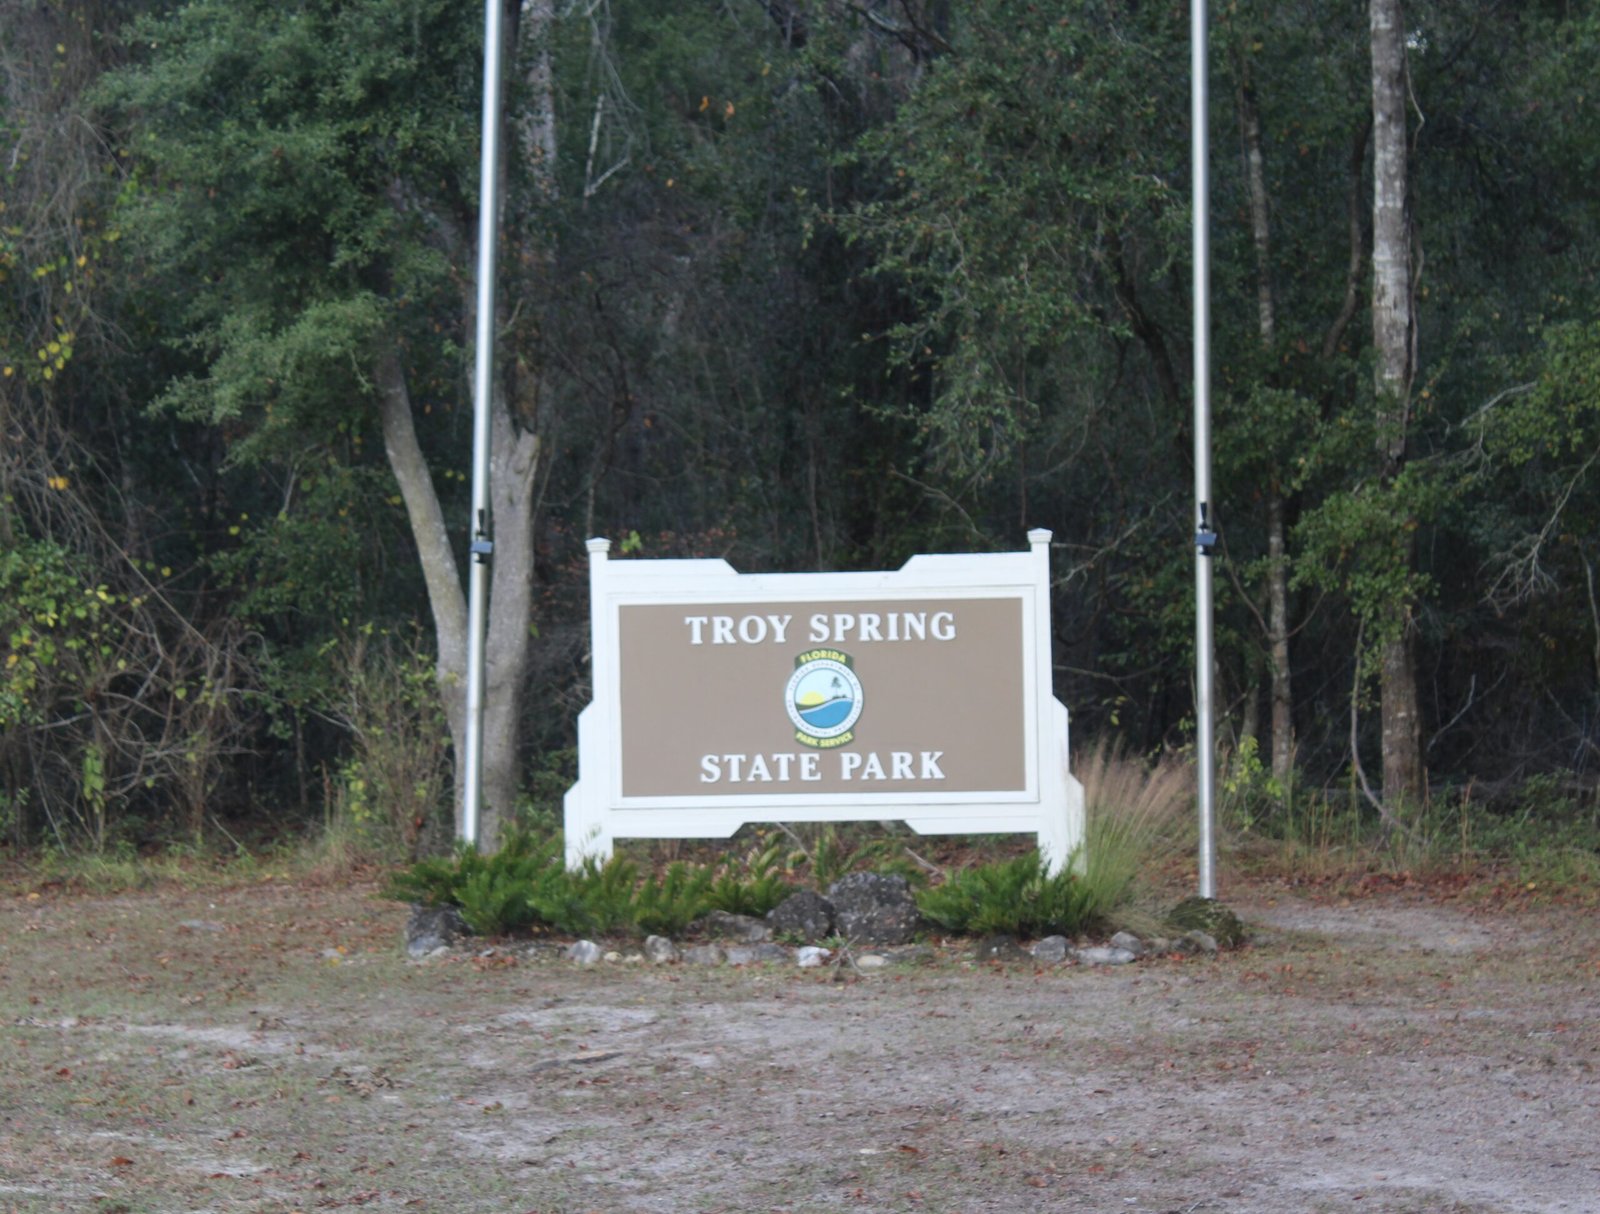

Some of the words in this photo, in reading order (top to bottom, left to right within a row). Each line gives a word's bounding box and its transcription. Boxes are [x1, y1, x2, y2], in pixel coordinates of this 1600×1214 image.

[684, 614, 793, 646] TROY
[808, 611, 957, 643] SPRING
[800, 649, 846, 664] FLORIDA
[795, 731, 818, 747] PARK
[819, 731, 854, 748] SERVICE
[700, 752, 822, 783] STATE
[839, 751, 947, 781] PARK
